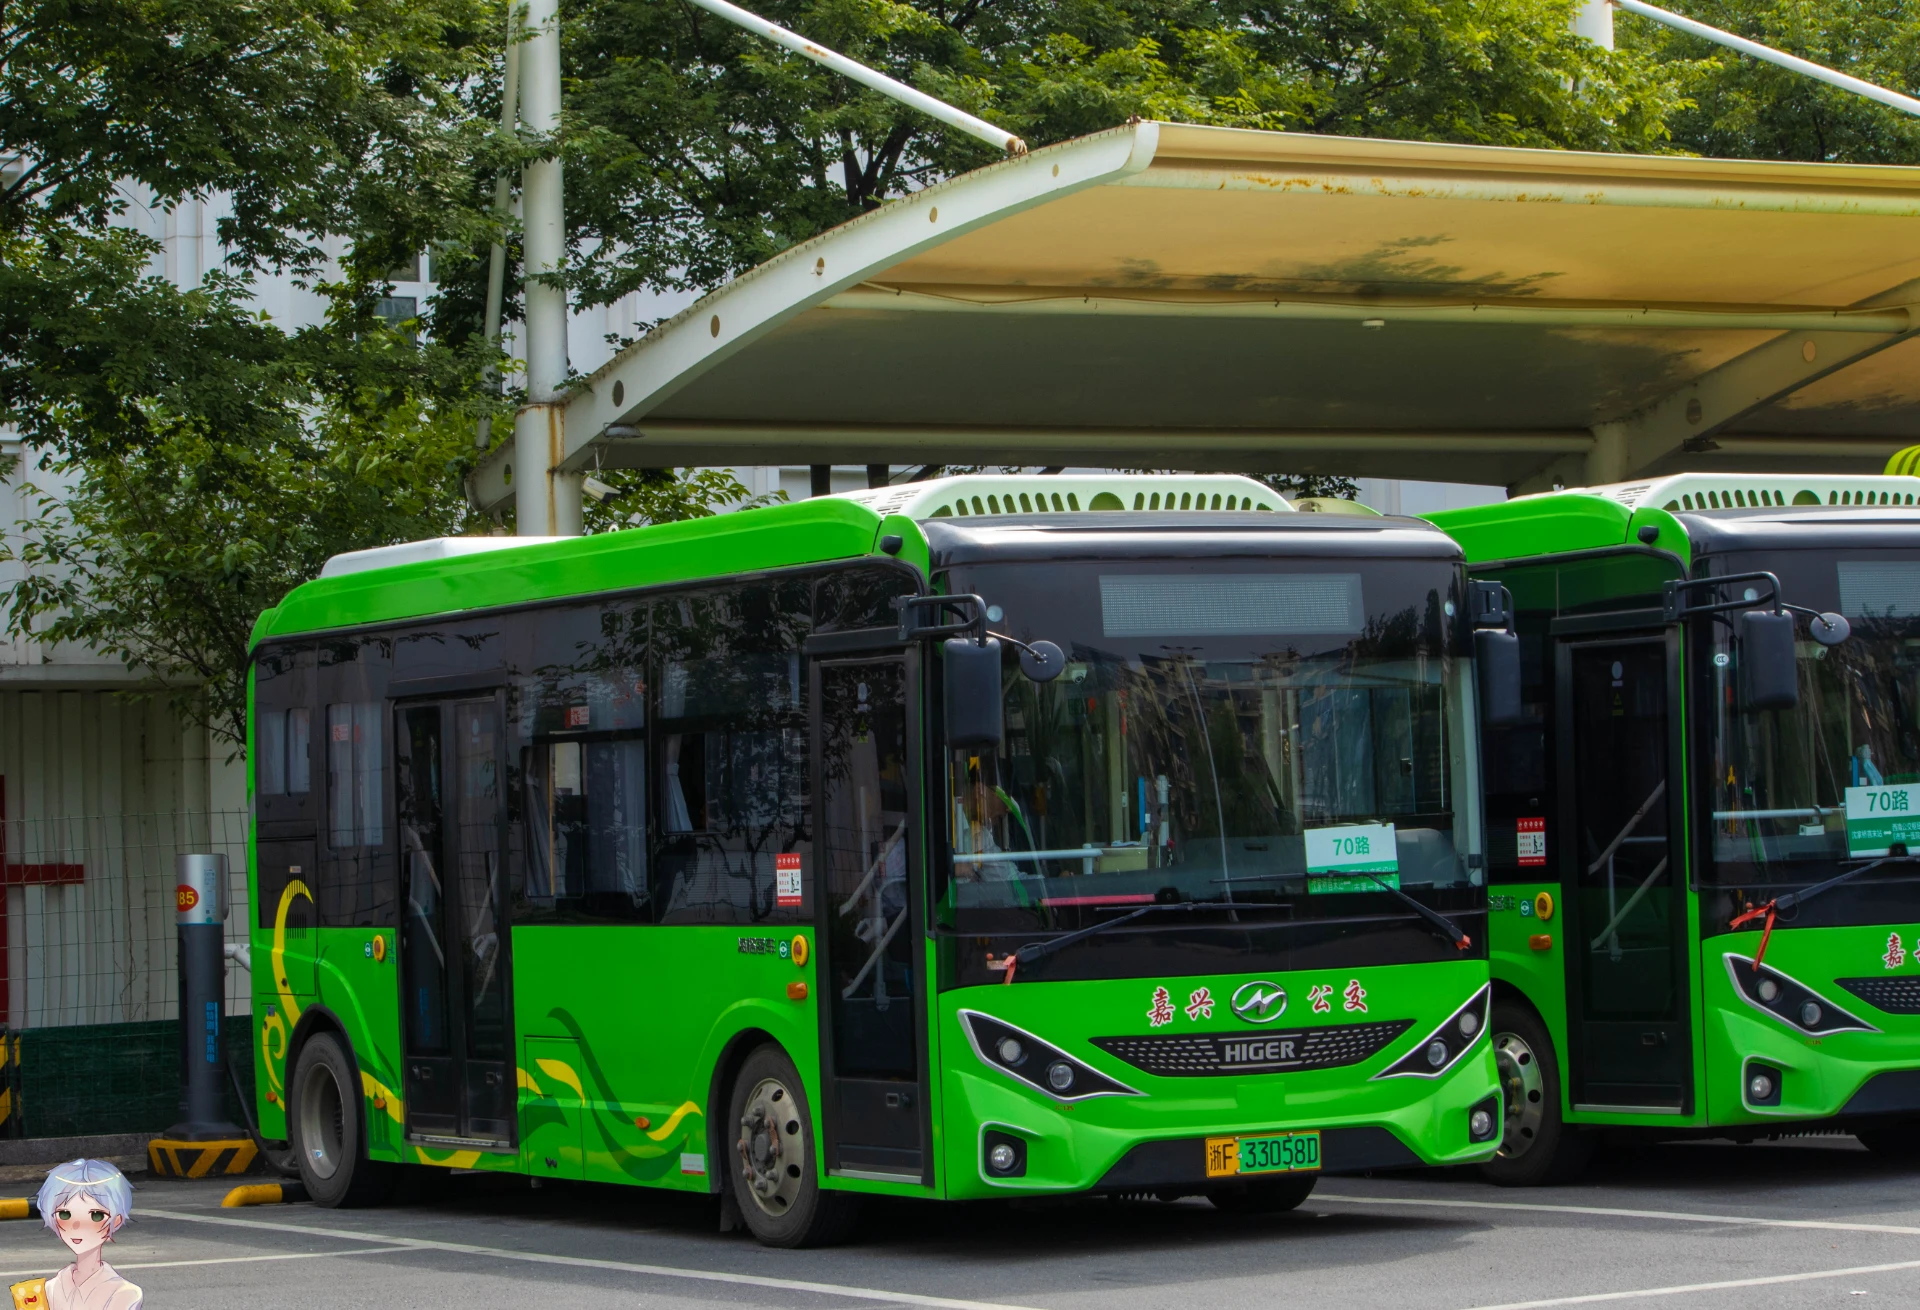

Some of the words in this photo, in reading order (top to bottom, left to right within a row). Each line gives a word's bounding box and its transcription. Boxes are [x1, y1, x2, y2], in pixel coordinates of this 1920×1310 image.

[1866, 790, 1909, 811] 70路
[1332, 836, 1370, 856] 70路
[1882, 932, 1920, 968] 嘉
[1147, 986, 1215, 1027] 嘉兴
[1307, 980, 1368, 1013] 公交
[1225, 1041, 1295, 1062] HIGER
[1245, 1137, 1319, 1168] 33058D
